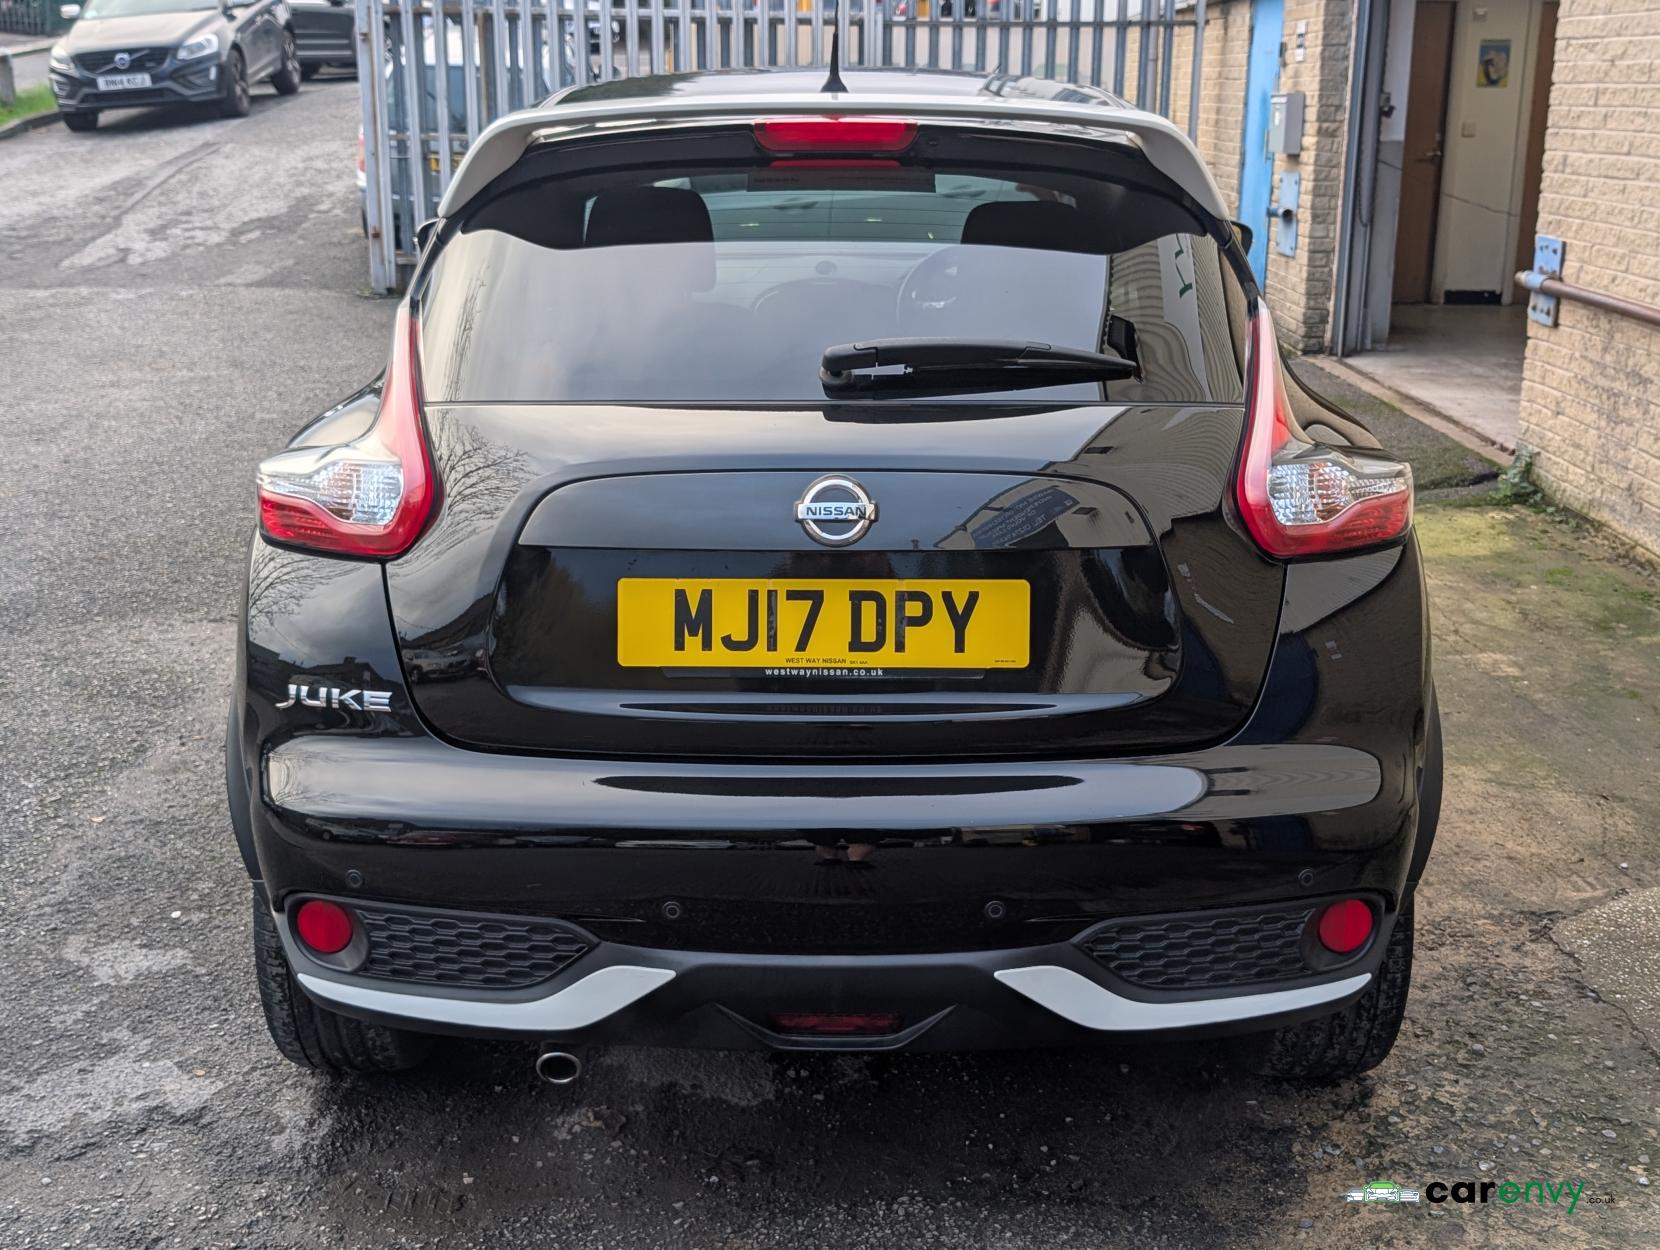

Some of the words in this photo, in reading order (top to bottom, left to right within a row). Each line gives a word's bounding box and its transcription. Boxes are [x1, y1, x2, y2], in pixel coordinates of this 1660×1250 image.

[806, 506, 866, 516] NISSAN
[674, 588, 824, 652] MJ17
[848, 590, 980, 653] DPY
[765, 668, 884, 677] westwaynissan.co.uk
[275, 684, 392, 712] JUKE
